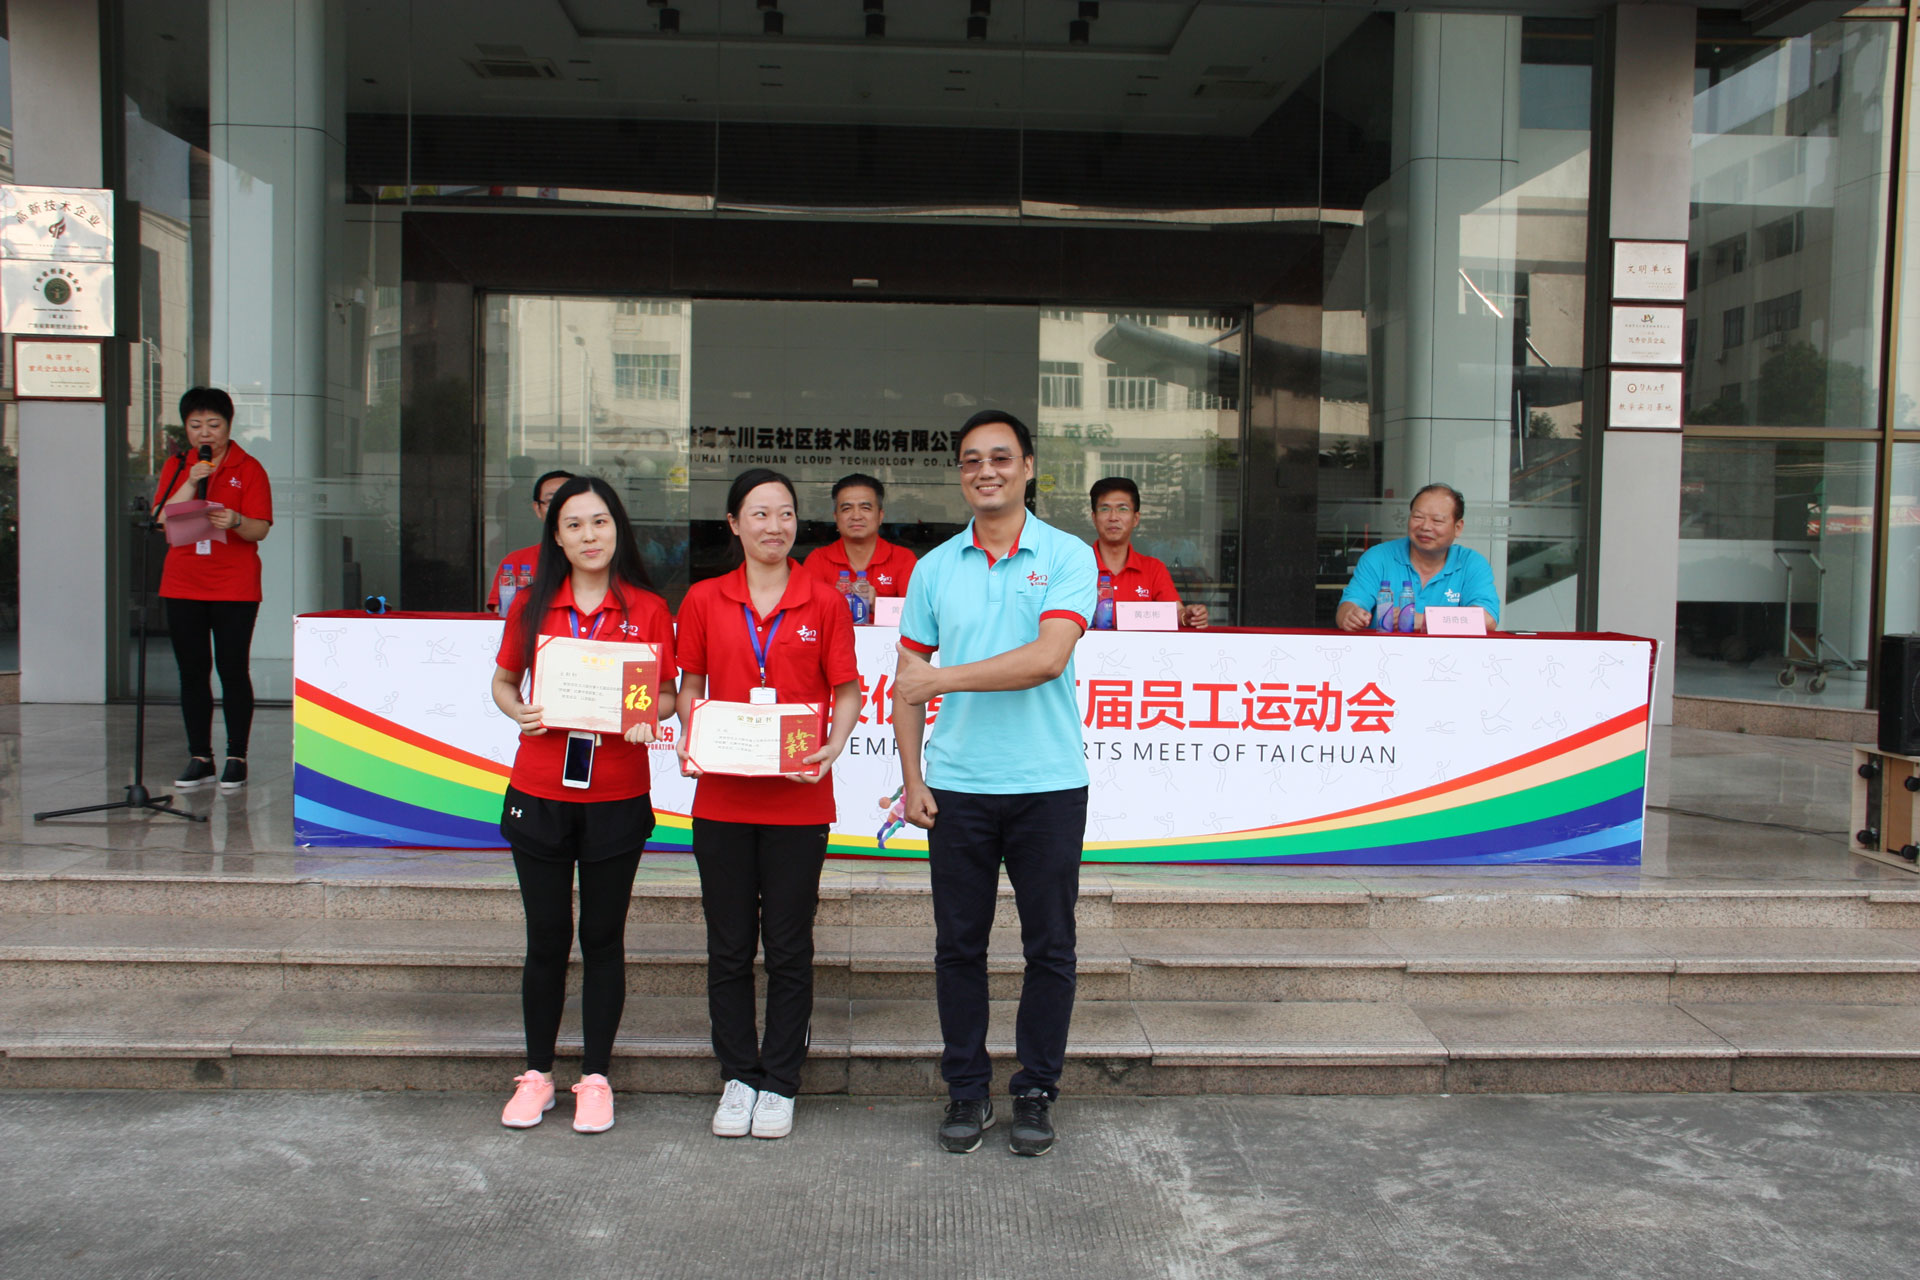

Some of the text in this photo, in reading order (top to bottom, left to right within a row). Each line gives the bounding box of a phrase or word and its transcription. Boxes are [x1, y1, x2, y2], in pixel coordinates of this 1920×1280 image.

[16, 199, 101, 228] 高新技术企业
[1626, 264, 1673, 275] 文明单位
[729, 454, 787, 465] TAICHUAN
[795, 456, 832, 465] CLOUD
[840, 456, 915, 466] TECHNOLOGY
[624, 684, 652, 712] 福
[1075, 679, 1397, 734] 届员工运动会
[1133, 742, 1203, 762] MEET
[1212, 743, 1247, 763] OF
[1256, 744, 1397, 764] TAICHUAN
